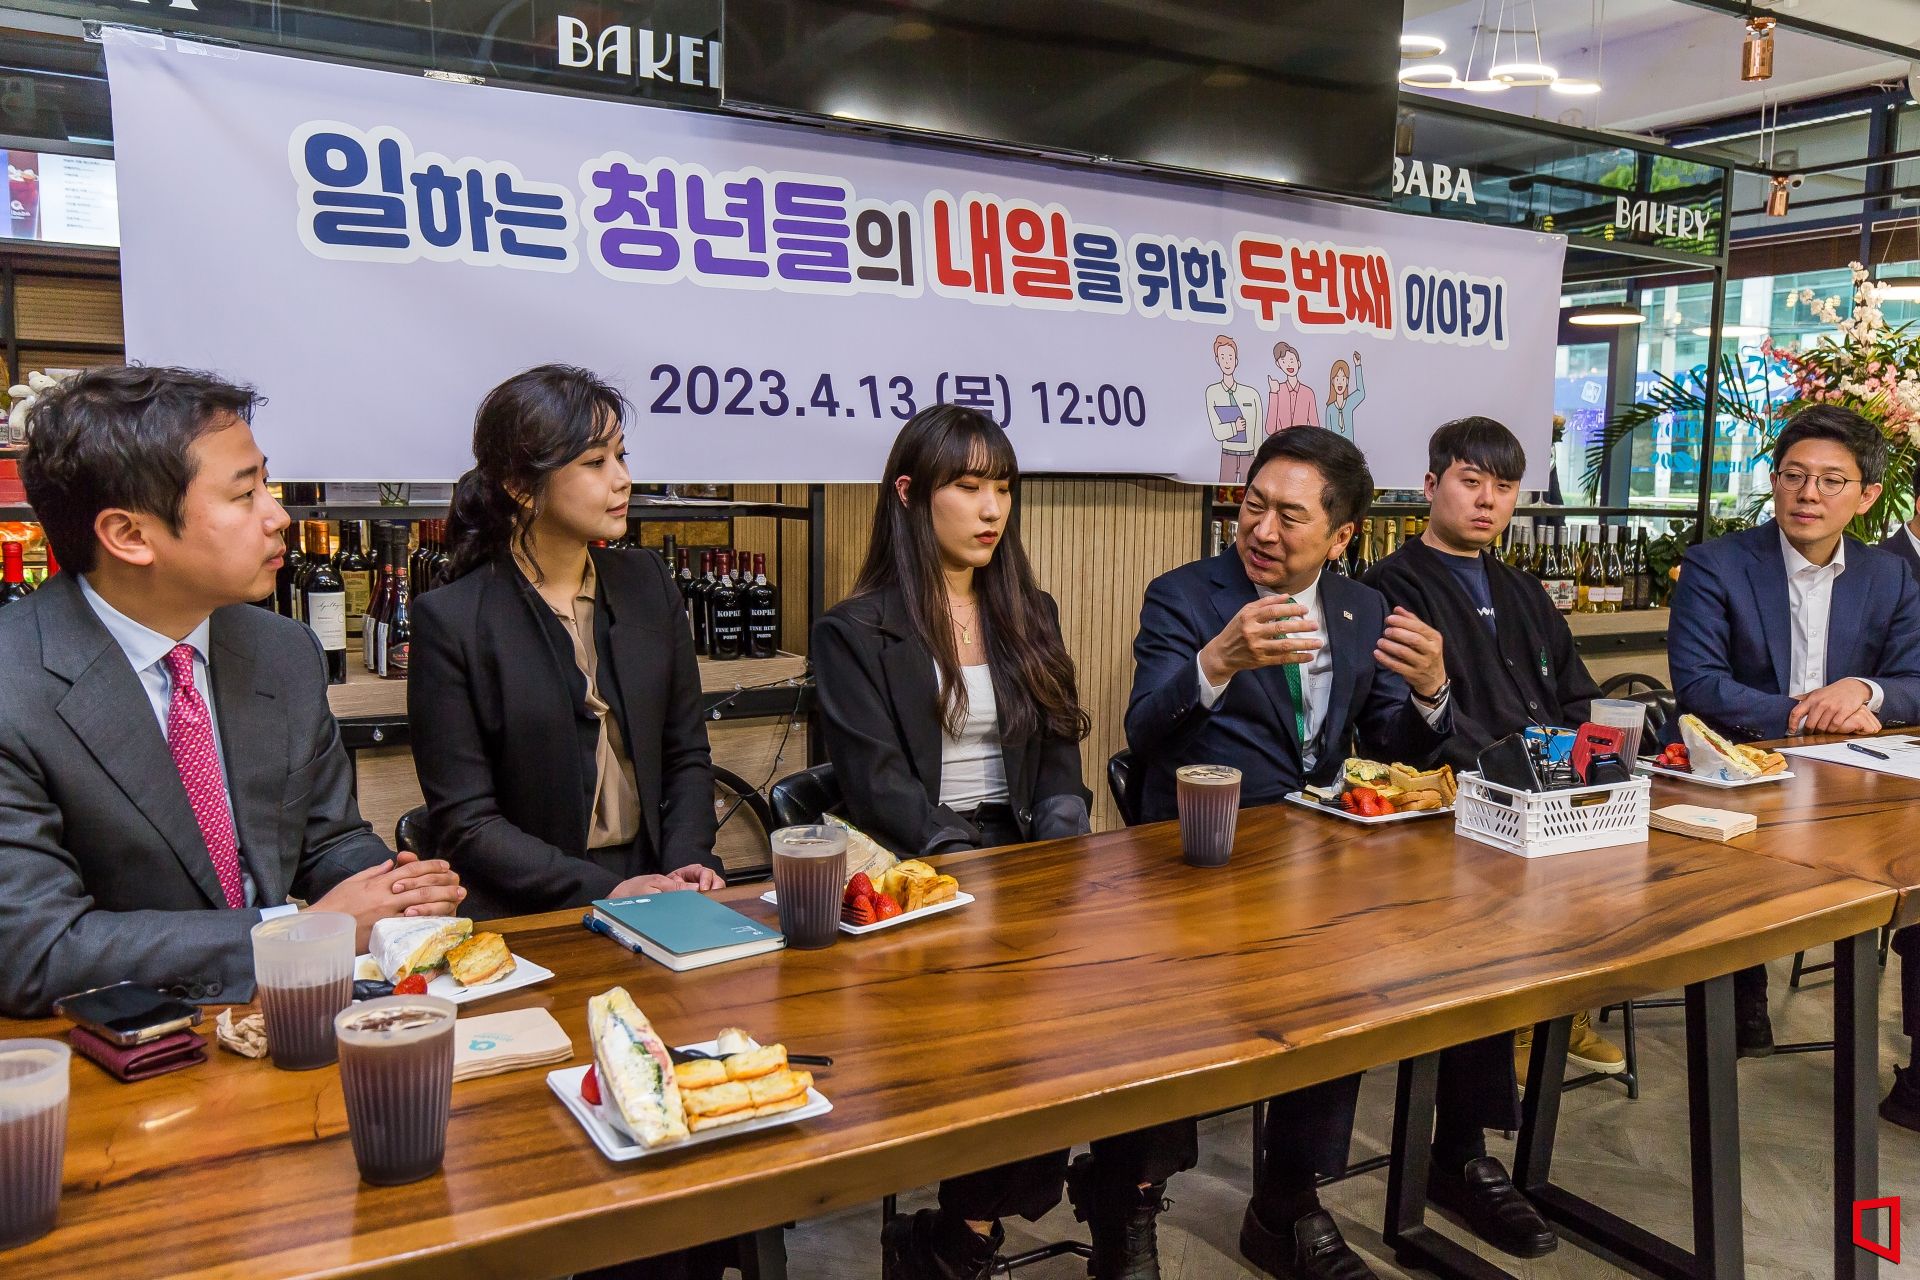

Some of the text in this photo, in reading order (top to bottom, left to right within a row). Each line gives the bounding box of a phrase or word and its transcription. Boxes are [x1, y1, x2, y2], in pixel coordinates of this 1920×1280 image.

[303, 131, 1507, 342] 일하는 청년들의 내일을 위한 두번째 이야기
[1615, 195, 1711, 242] BAKERY
[648, 363, 917, 421] 2023.4.13
[1031, 380, 1147, 428] 12:00
